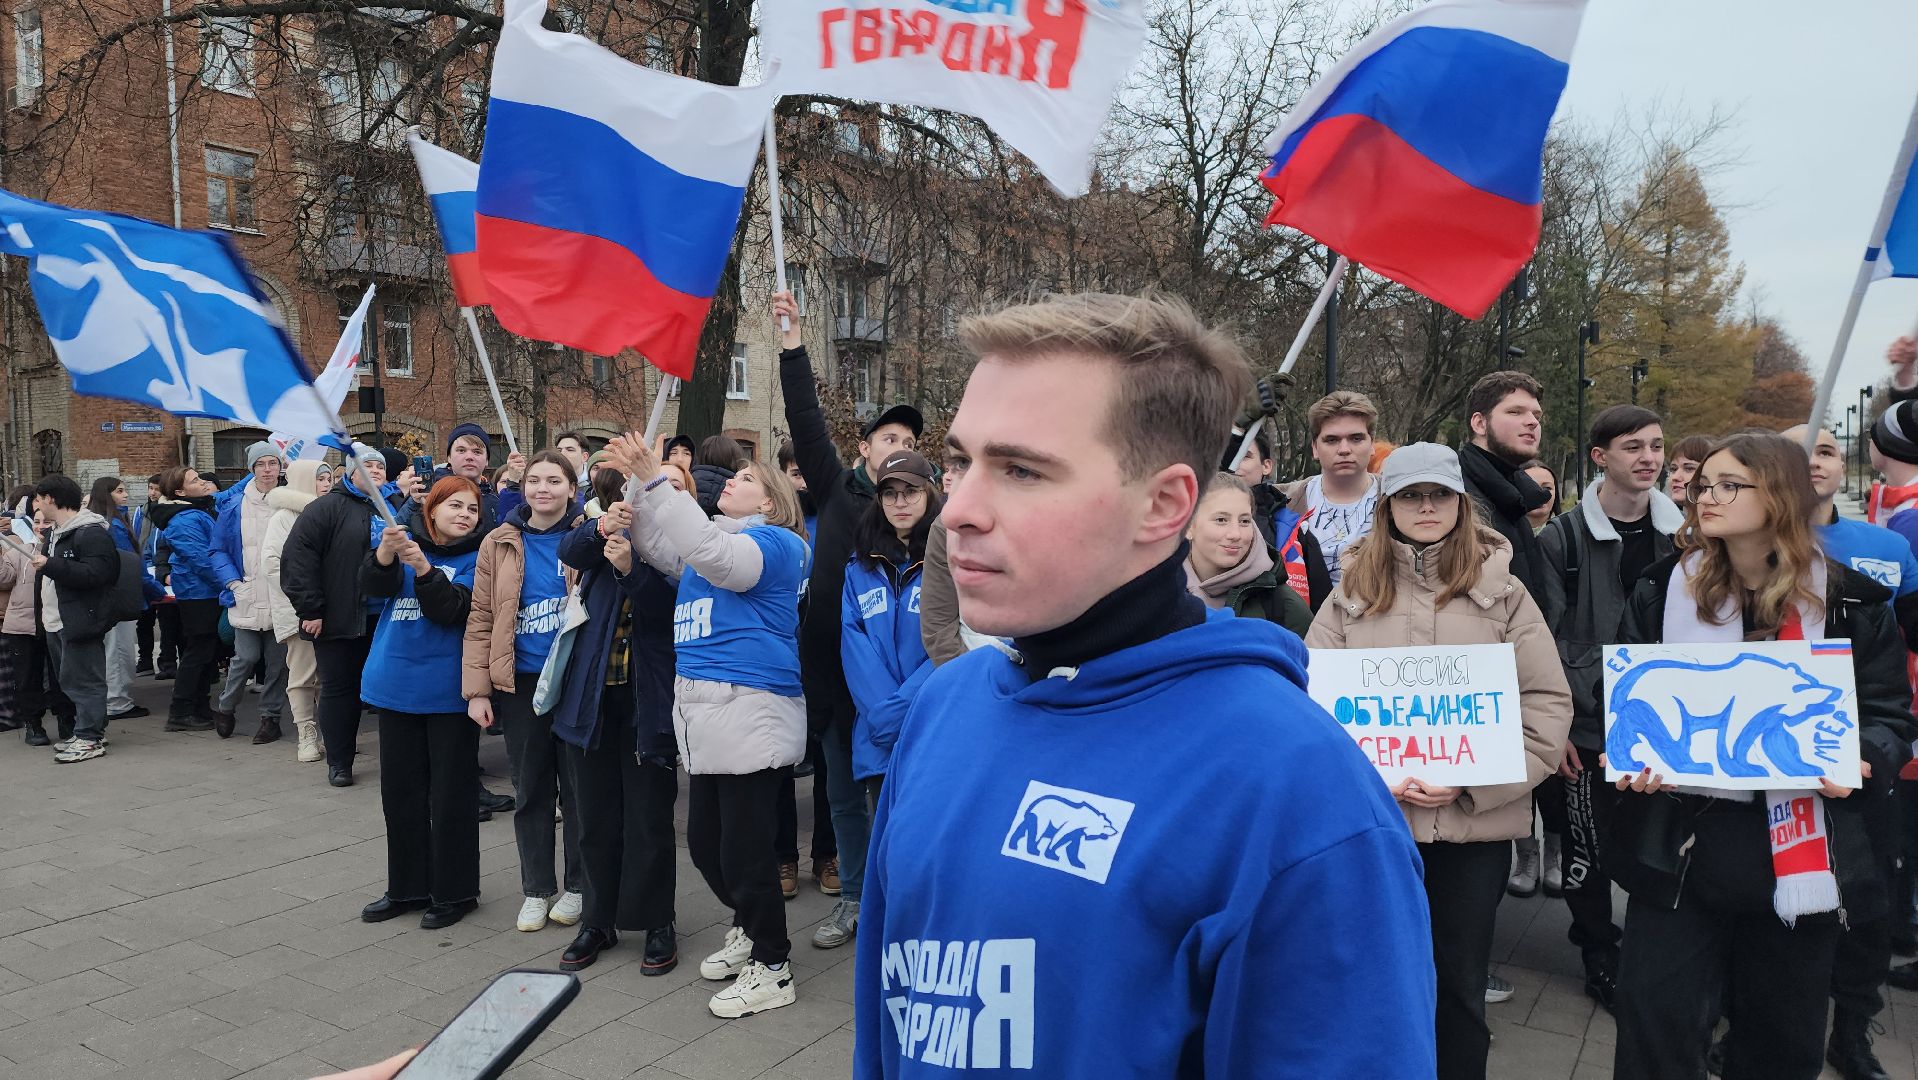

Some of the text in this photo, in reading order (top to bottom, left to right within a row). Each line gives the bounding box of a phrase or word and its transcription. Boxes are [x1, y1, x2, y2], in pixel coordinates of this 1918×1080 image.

[820, 0, 1088, 89] ГВАРДИЯ
[1361, 655, 1470, 687] РОССИЯ
[1606, 647, 1632, 673] ЕР
[1334, 692, 1503, 726] ОБЪЕДИНЯЕТ
[1814, 710, 1854, 763] МГЕР
